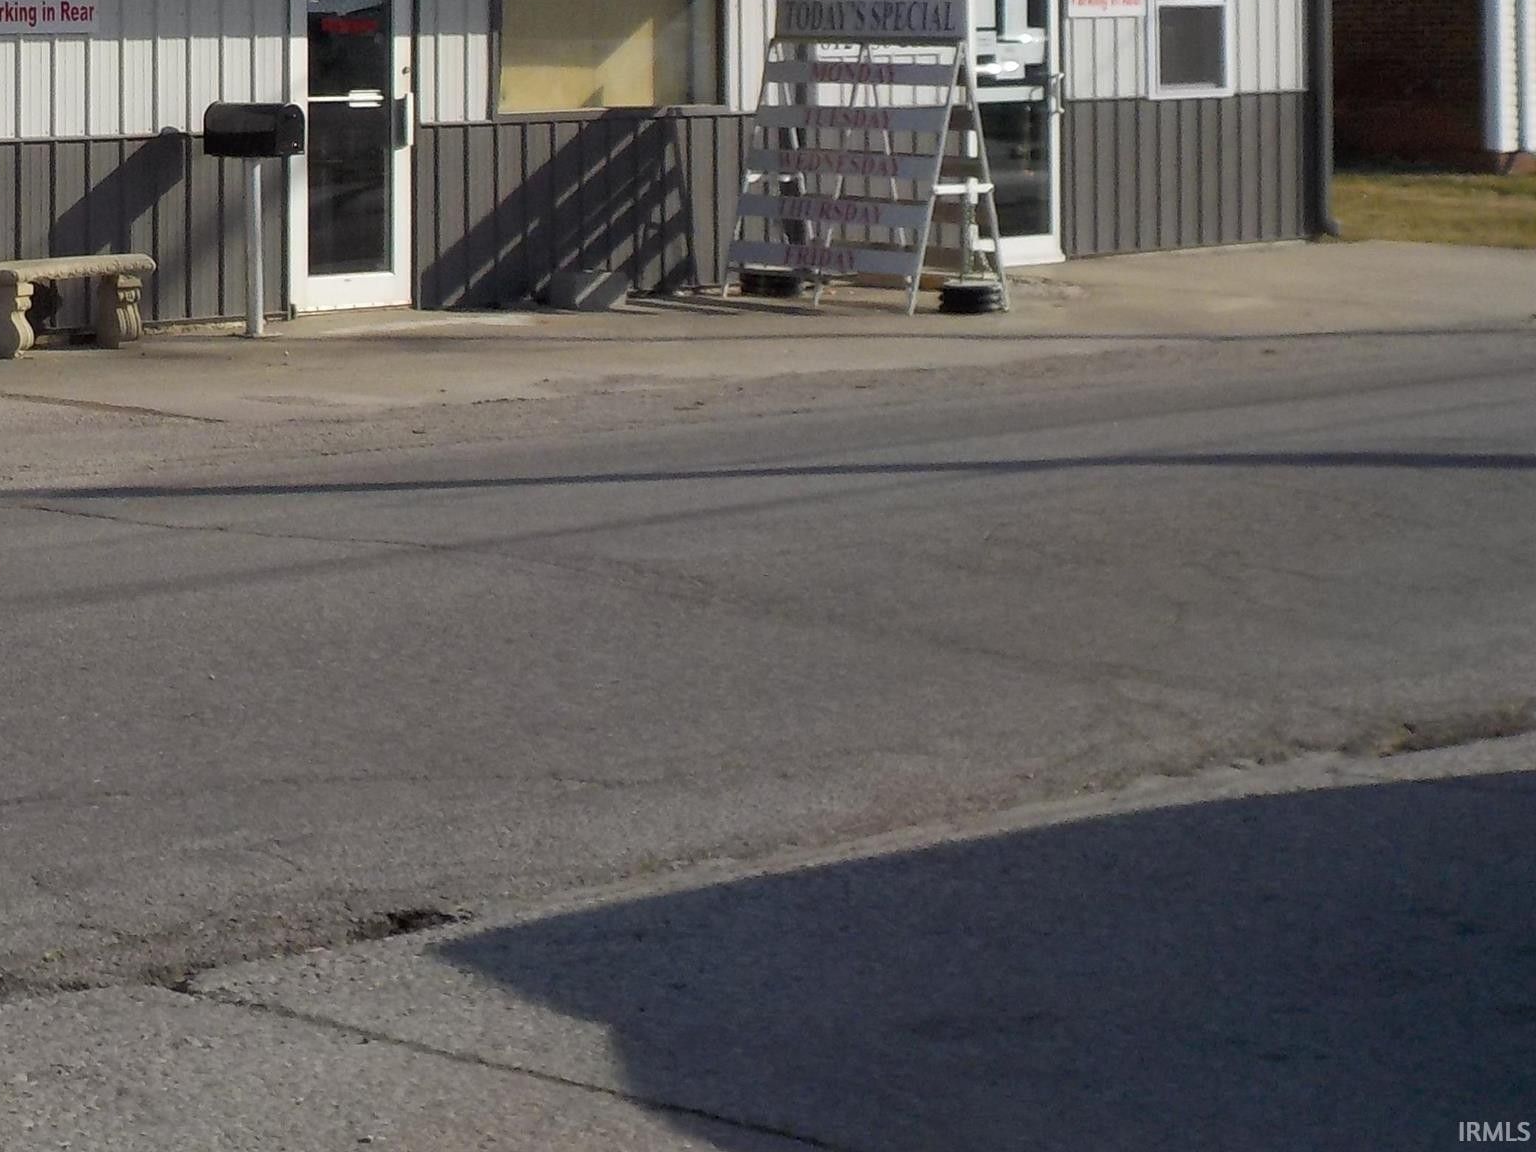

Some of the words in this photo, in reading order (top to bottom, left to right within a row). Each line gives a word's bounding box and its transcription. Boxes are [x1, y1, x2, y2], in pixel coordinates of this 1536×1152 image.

[42, 1, 55, 21] in
[60, 1, 95, 21] Rear
[785, 0, 865, 31] TODAY'S
[869, 1, 957, 32] SPECIAL
[811, 63, 897, 84] MONDAY
[804, 108, 893, 129] TUESDAY
[779, 150, 900, 176] WEDNESDAY
[779, 198, 883, 225] THURSDAY
[783, 247, 856, 270] FRIDAY
